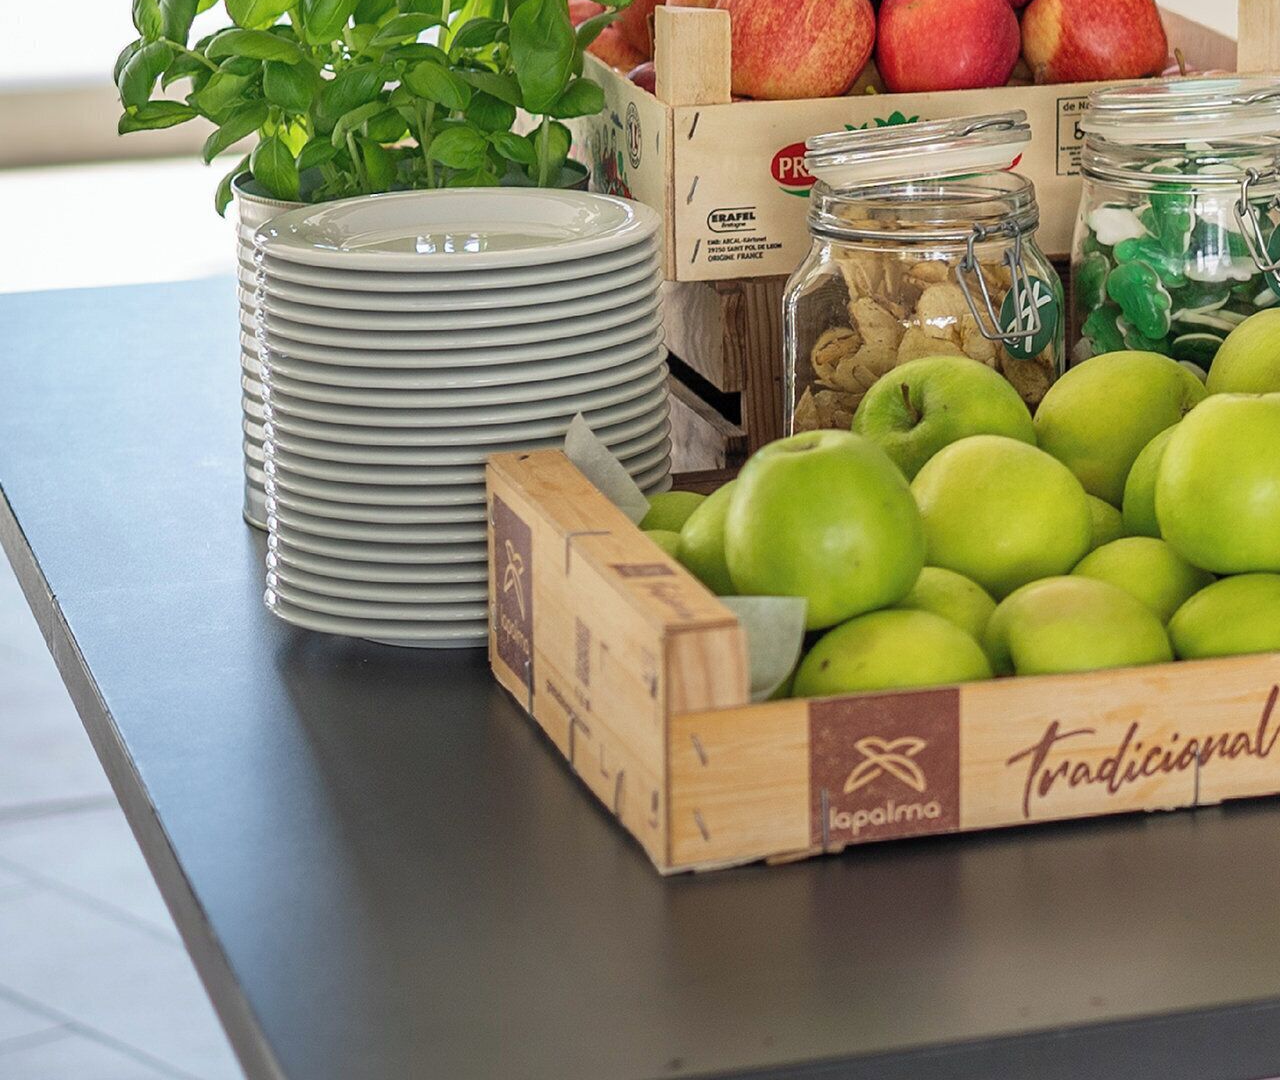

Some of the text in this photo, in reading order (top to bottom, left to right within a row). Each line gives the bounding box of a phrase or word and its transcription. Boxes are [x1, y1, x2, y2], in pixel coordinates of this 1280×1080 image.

[1063, 101, 1076, 112] de
[779, 156, 810, 179] PR
[711, 211, 756, 223] ERAFEL
[727, 245, 744, 253] SAINT
[744, 244, 757, 252] POL
[757, 243, 766, 251] DE
[707, 251, 764, 263] ORIGINE FRANCE
[829, 798, 942, 836] lapalma
